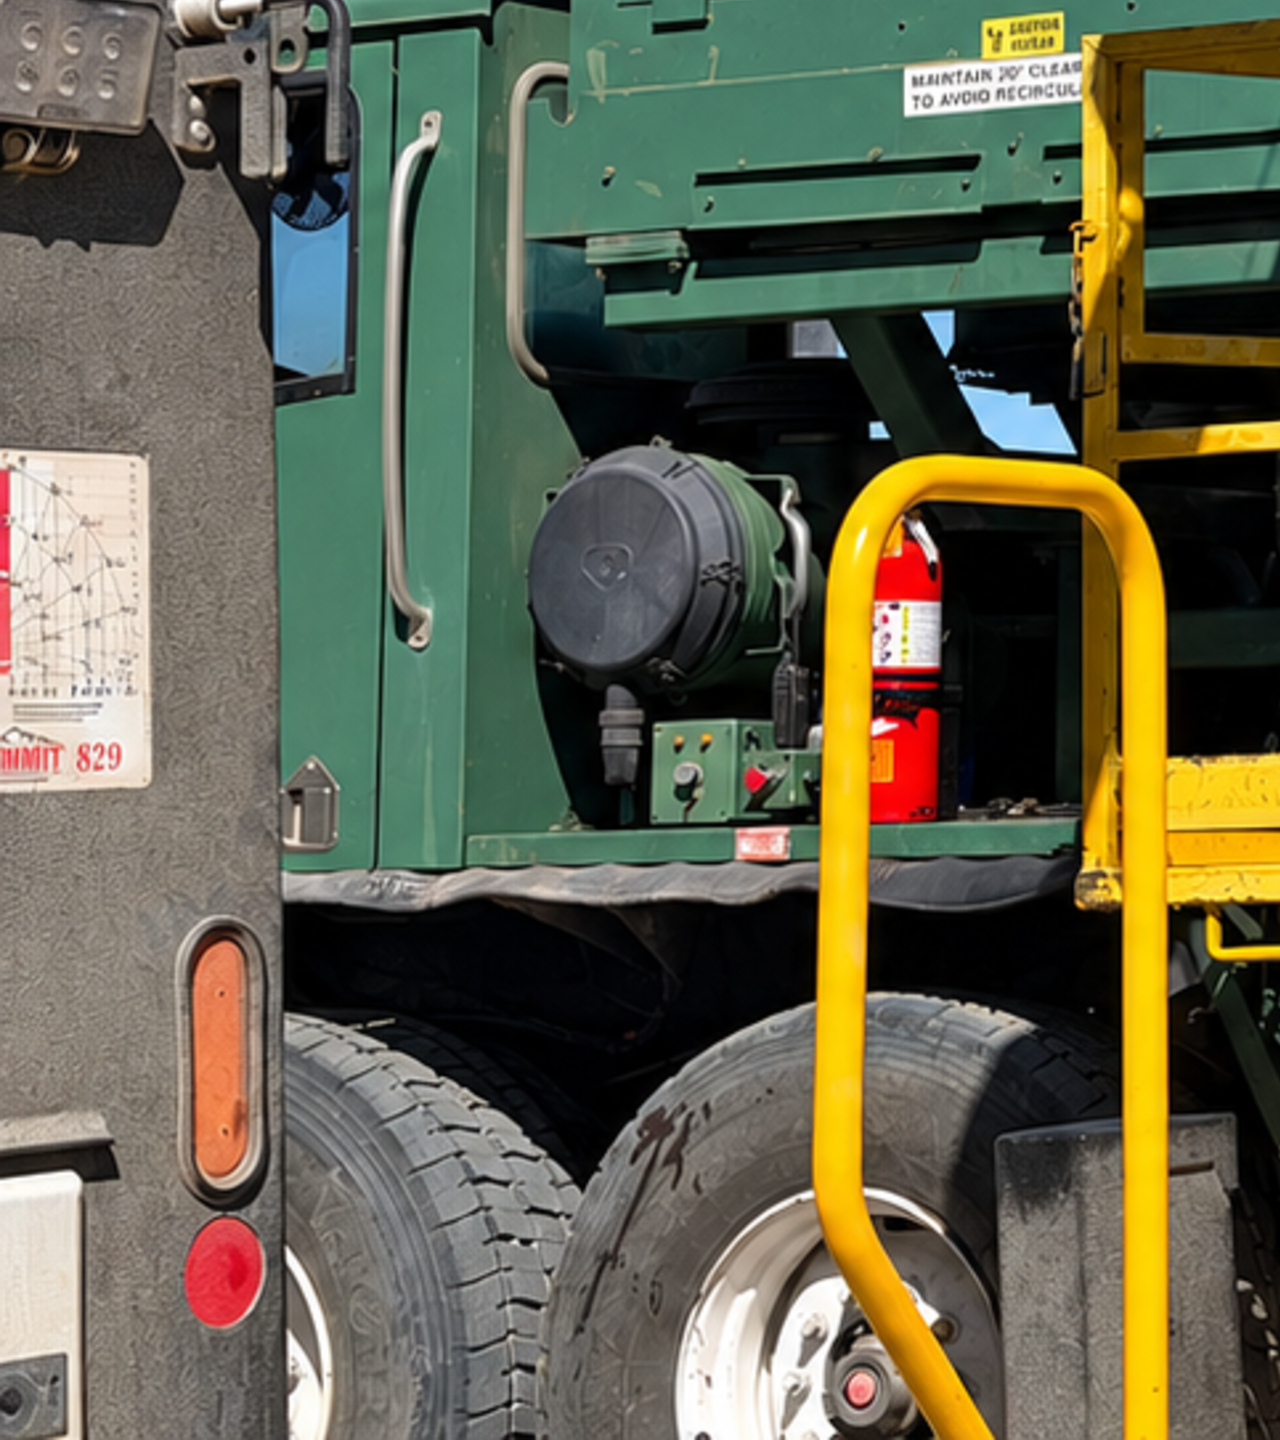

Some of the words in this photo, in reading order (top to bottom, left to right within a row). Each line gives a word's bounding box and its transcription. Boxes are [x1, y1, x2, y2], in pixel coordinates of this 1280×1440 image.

[911, 67, 993, 89] MAINTAIN
[911, 94, 935, 110] TO
[938, 88, 991, 108] AVOID
[76, 741, 123, 773] 829
